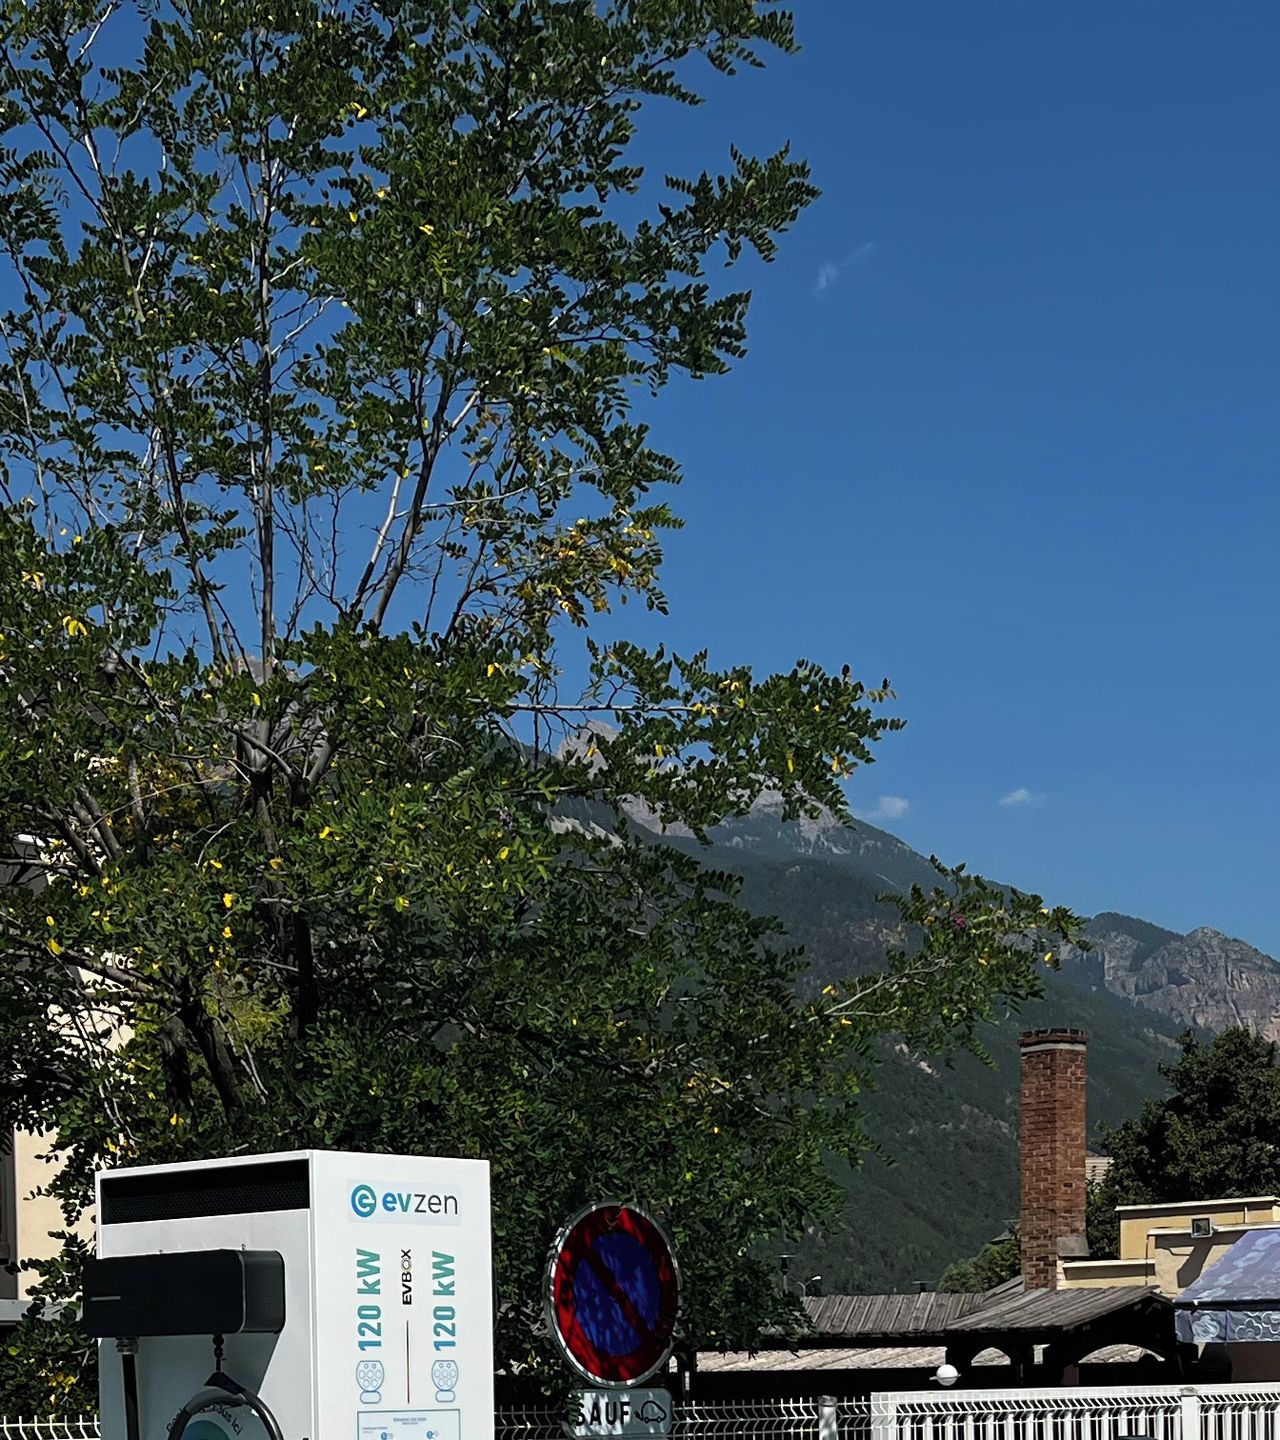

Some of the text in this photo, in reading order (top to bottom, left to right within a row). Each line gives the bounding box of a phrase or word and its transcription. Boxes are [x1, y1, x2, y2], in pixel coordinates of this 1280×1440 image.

[382, 1192, 458, 1215] evzen
[356, 1248, 381, 1351] 120 kW
[401, 1249, 412, 1305] EVBOX
[432, 1251, 456, 1351] 120 kW
[576, 1401, 631, 1426] SAUF
